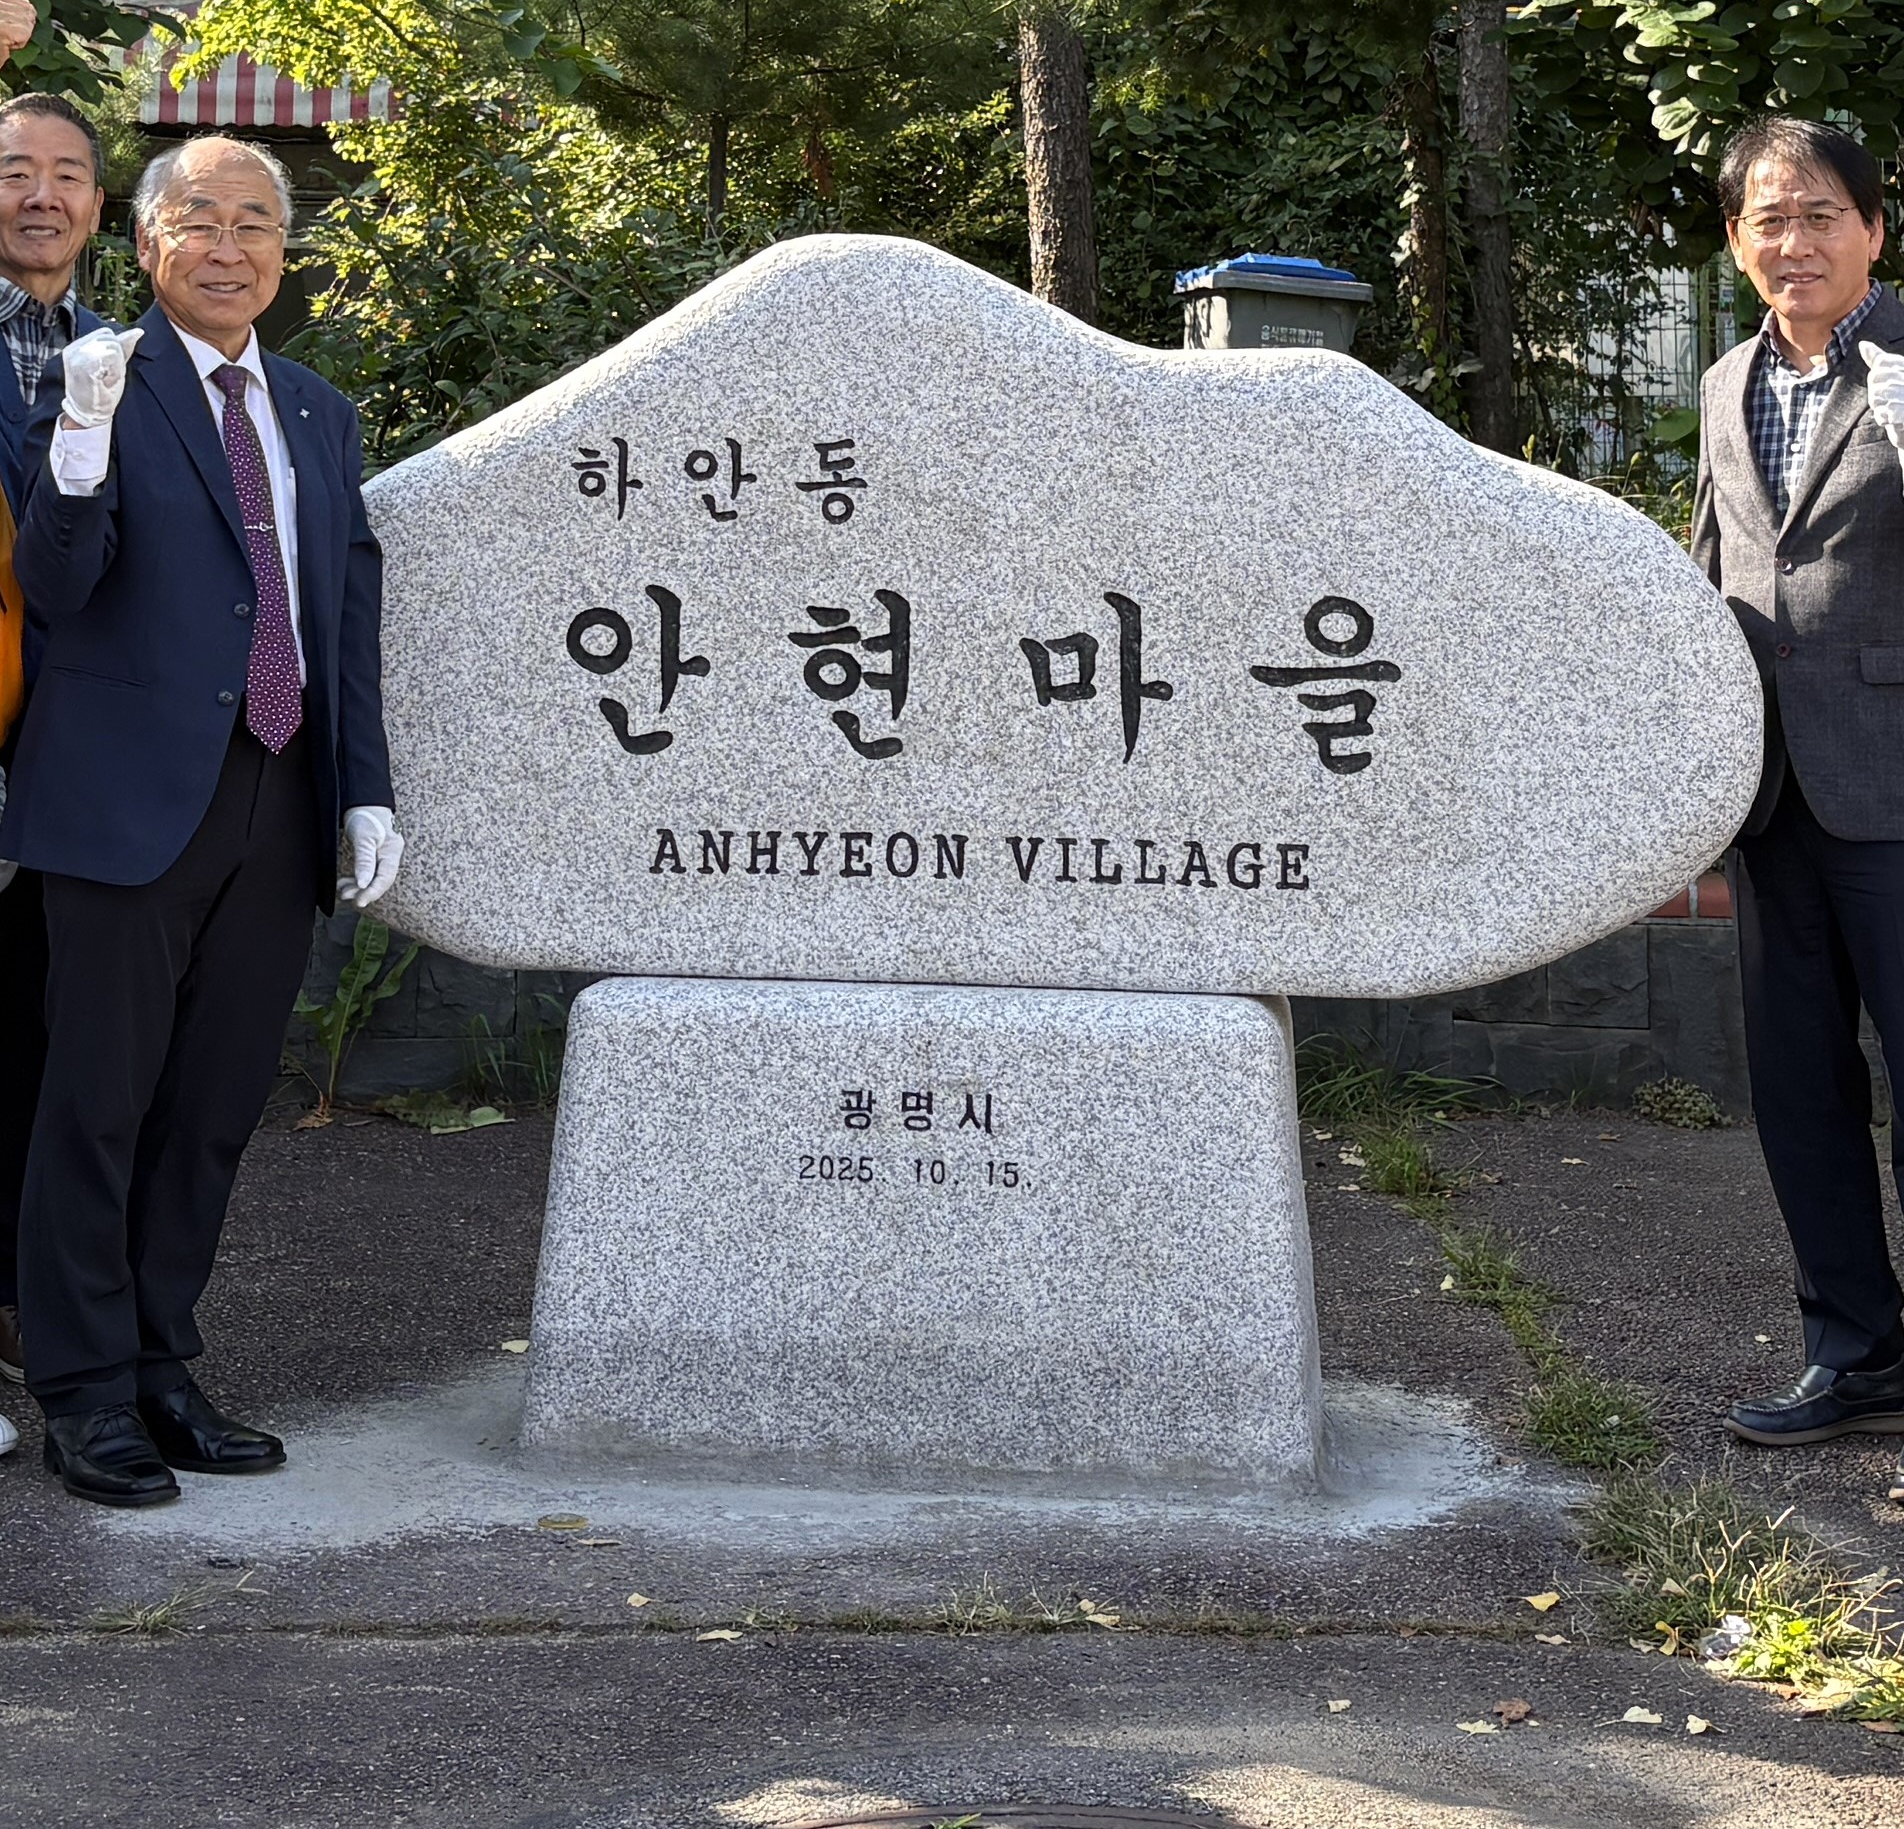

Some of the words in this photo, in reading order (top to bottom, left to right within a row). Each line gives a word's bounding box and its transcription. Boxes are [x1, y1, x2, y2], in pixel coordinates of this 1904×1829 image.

[650, 828, 968, 879] ANHYEON
[1007, 836, 1312, 891] VILLAGE
[840, 1087, 995, 1134] 광명시
[913, 1158, 961, 1186] 10.
[985, 1160, 1033, 1189] 15.
